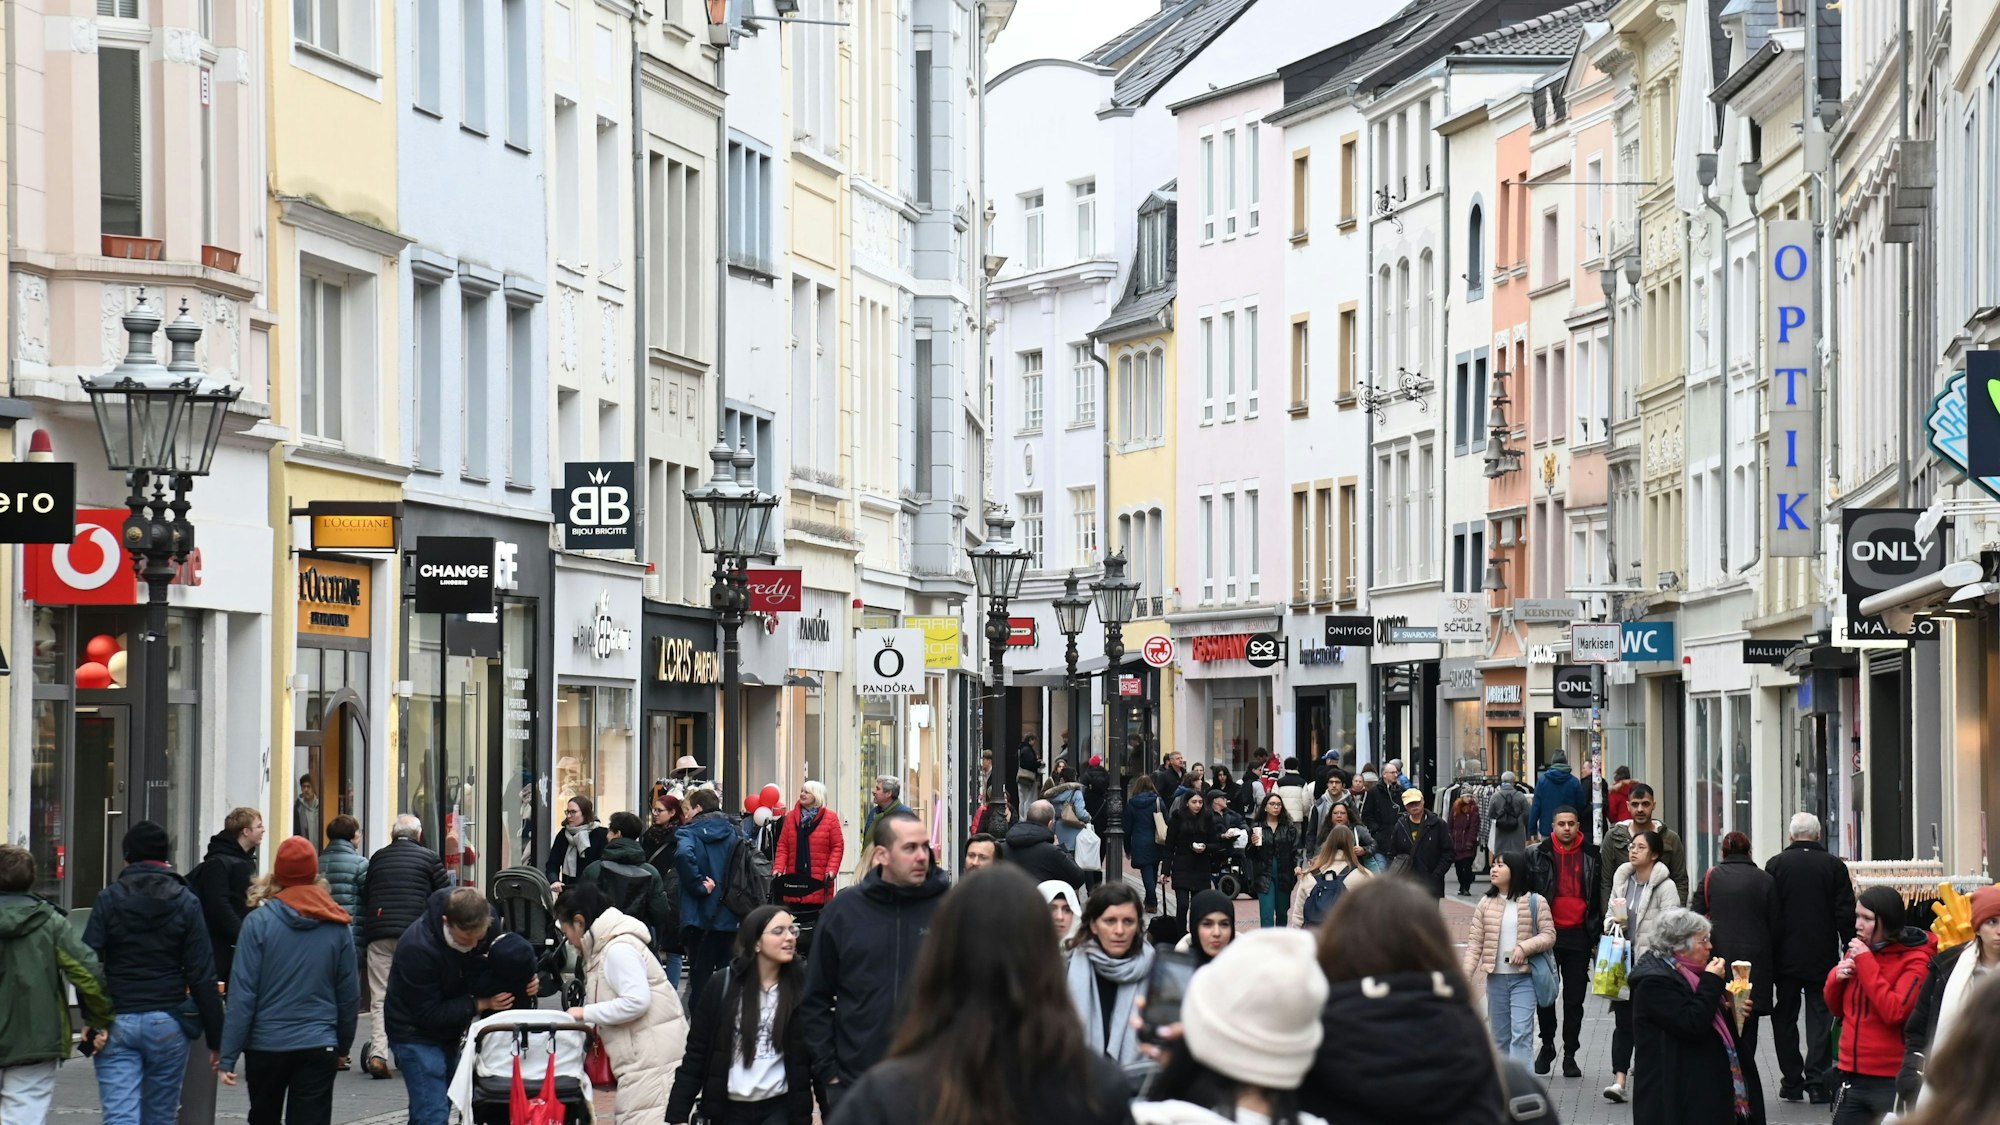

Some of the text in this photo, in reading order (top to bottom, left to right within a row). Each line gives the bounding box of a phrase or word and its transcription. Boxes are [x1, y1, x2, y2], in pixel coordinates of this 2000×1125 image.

[1774, 244, 1810, 530] OPTIK
[572, 527, 627, 536] BIJOU BRIGITTE
[1852, 540, 1935, 562] ONLY
[420, 564, 489, 578] CHANGE
[746, 577, 796, 605] redy
[1524, 609, 1574, 618] KERSTING
[1444, 623, 1482, 632] SCHULZ
[1854, 621, 1934, 635] MAGO
[1401, 631, 1437, 639] SWAROVSK
[1621, 630, 1658, 654] WC
[1749, 647, 1790, 656] HALLHU
[863, 683, 915, 693] PANDORA
